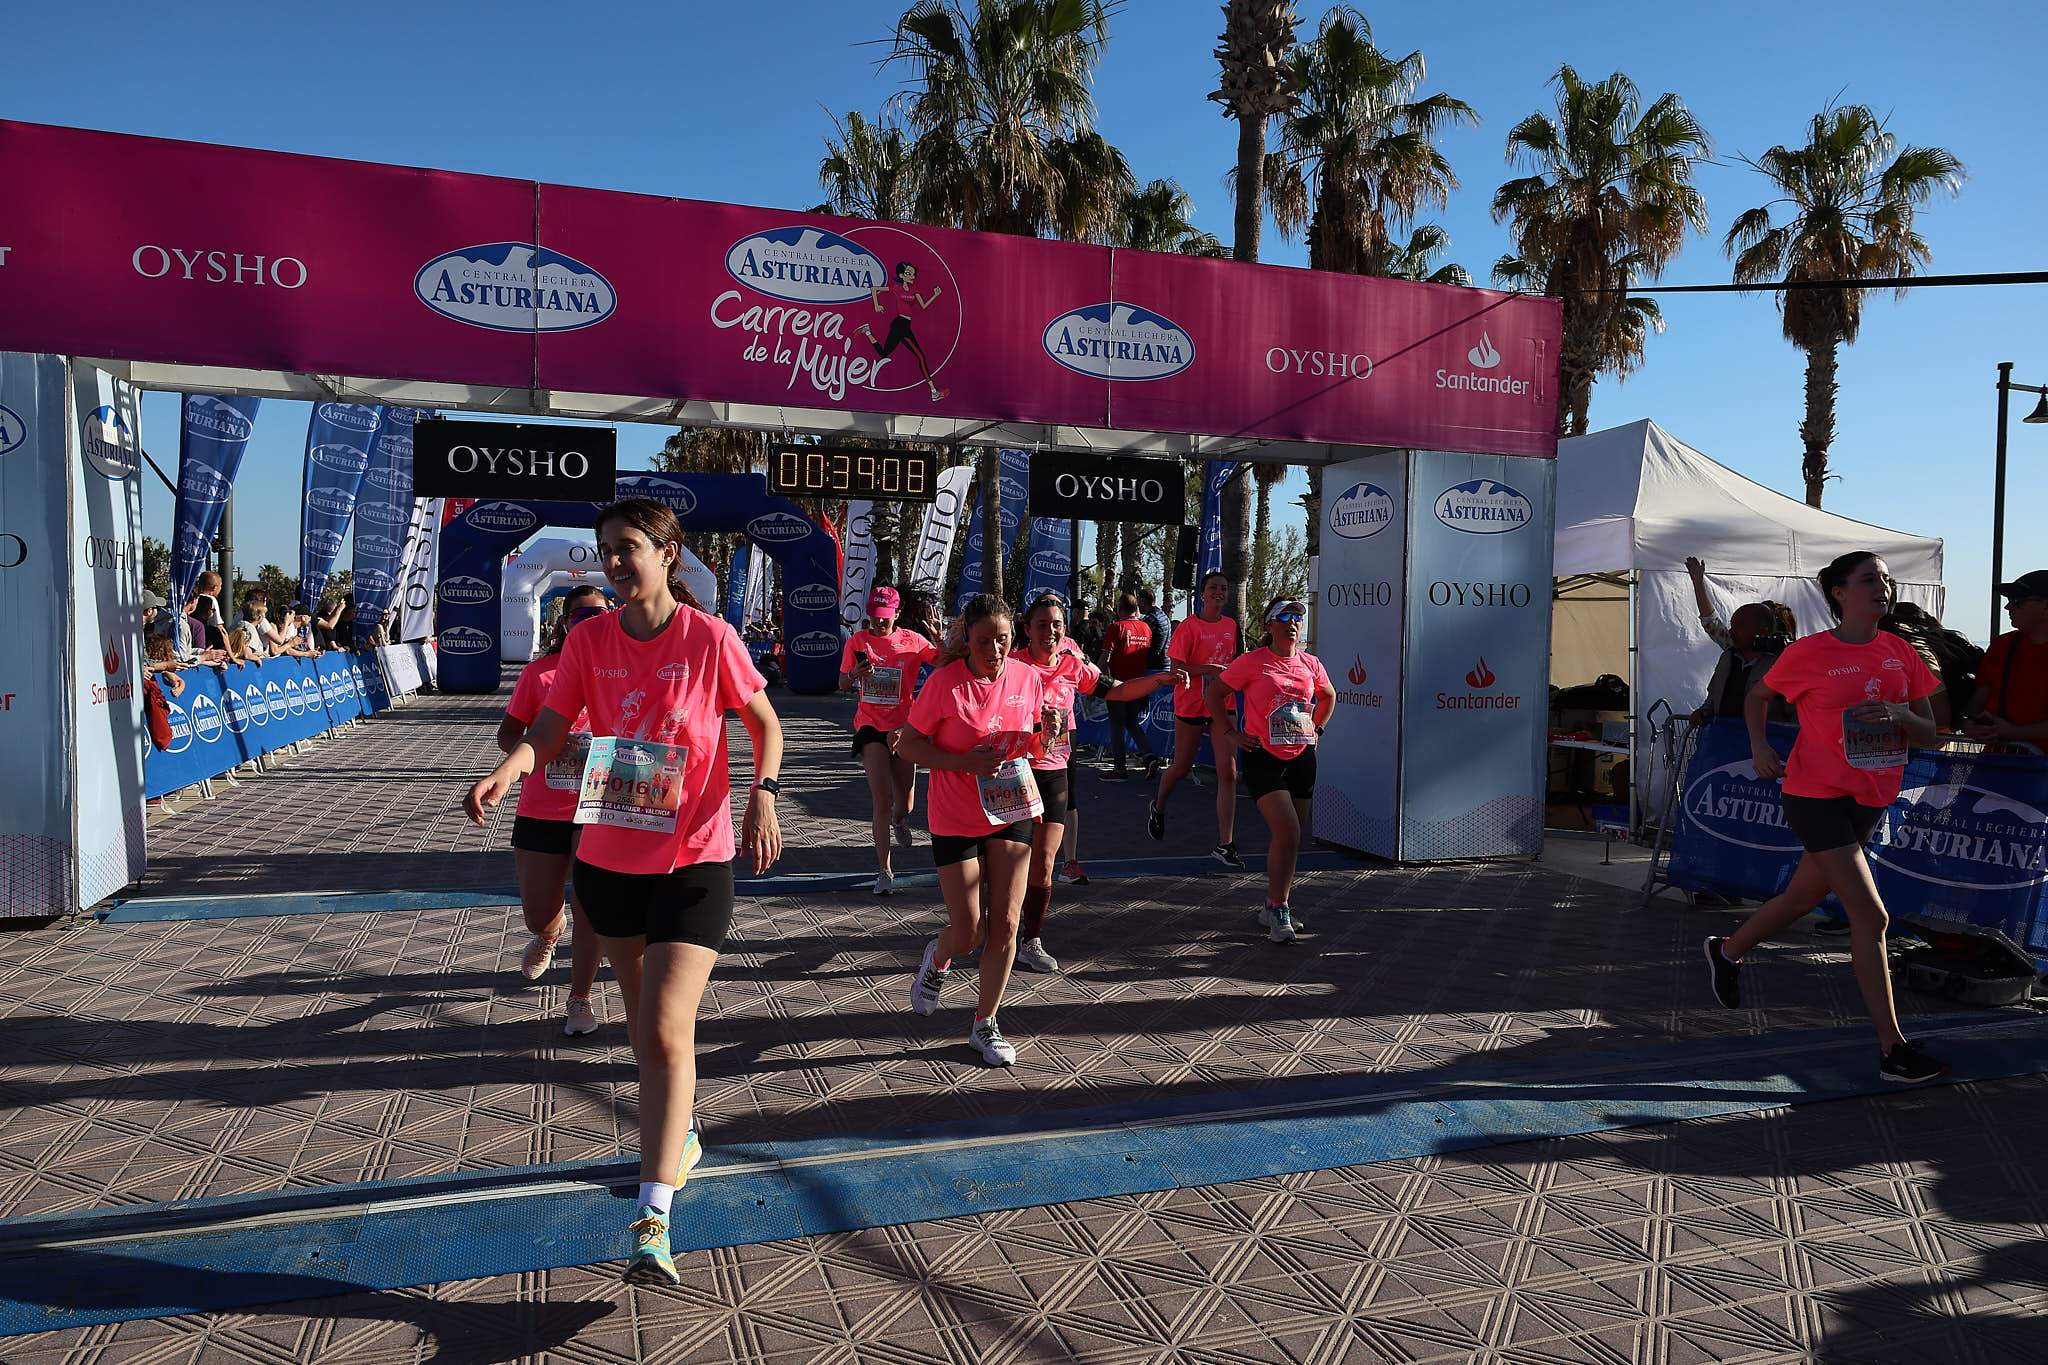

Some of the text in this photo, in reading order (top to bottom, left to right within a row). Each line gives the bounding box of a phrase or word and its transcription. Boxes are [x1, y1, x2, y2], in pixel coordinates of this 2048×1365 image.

[132, 244, 308, 290] OYSHO
[738, 248, 874, 289] ASTURIANA
[764, 248, 871, 267] CENTRAL LECHERA
[431, 269, 602, 314] ASTURIANA
[463, 269, 596, 288] CENTRAL ECHERA
[710, 290, 844, 340] Carrera
[1055, 326, 1184, 364] ASTURIANA
[1079, 326, 1179, 342] CENTRAL LECHERA
[743, 335, 892, 401] de la Mujer
[1265, 347, 1374, 381] OYSHO
[1435, 369, 1530, 396] Santander
[188, 412, 245, 438] TURIANA
[447, 444, 590, 479] OYSHO
[780, 452, 925, 493] 00:39:08
[1055, 473, 1164, 503] OYSHO
[1333, 506, 1389, 528] ASTURIANA
[1441, 498, 1526, 522] ASTURIANA
[753, 521, 809, 536] ASTURIANA
[85, 534, 137, 573] OYSHO
[1328, 581, 1392, 608] OYSHO
[1429, 581, 1532, 609] OYSHO
[593, 667, 628, 679] OYSHO
[1828, 666, 1862, 677] OYSHO
[1336, 687, 1383, 709] antander
[1436, 692, 1521, 711] Santander
[1722, 783, 1774, 798] CENTRAL
[584, 812, 615, 820] OYSHO
[622, 805, 641, 813] MUJER
[645, 807, 671, 816] VALENCIA
